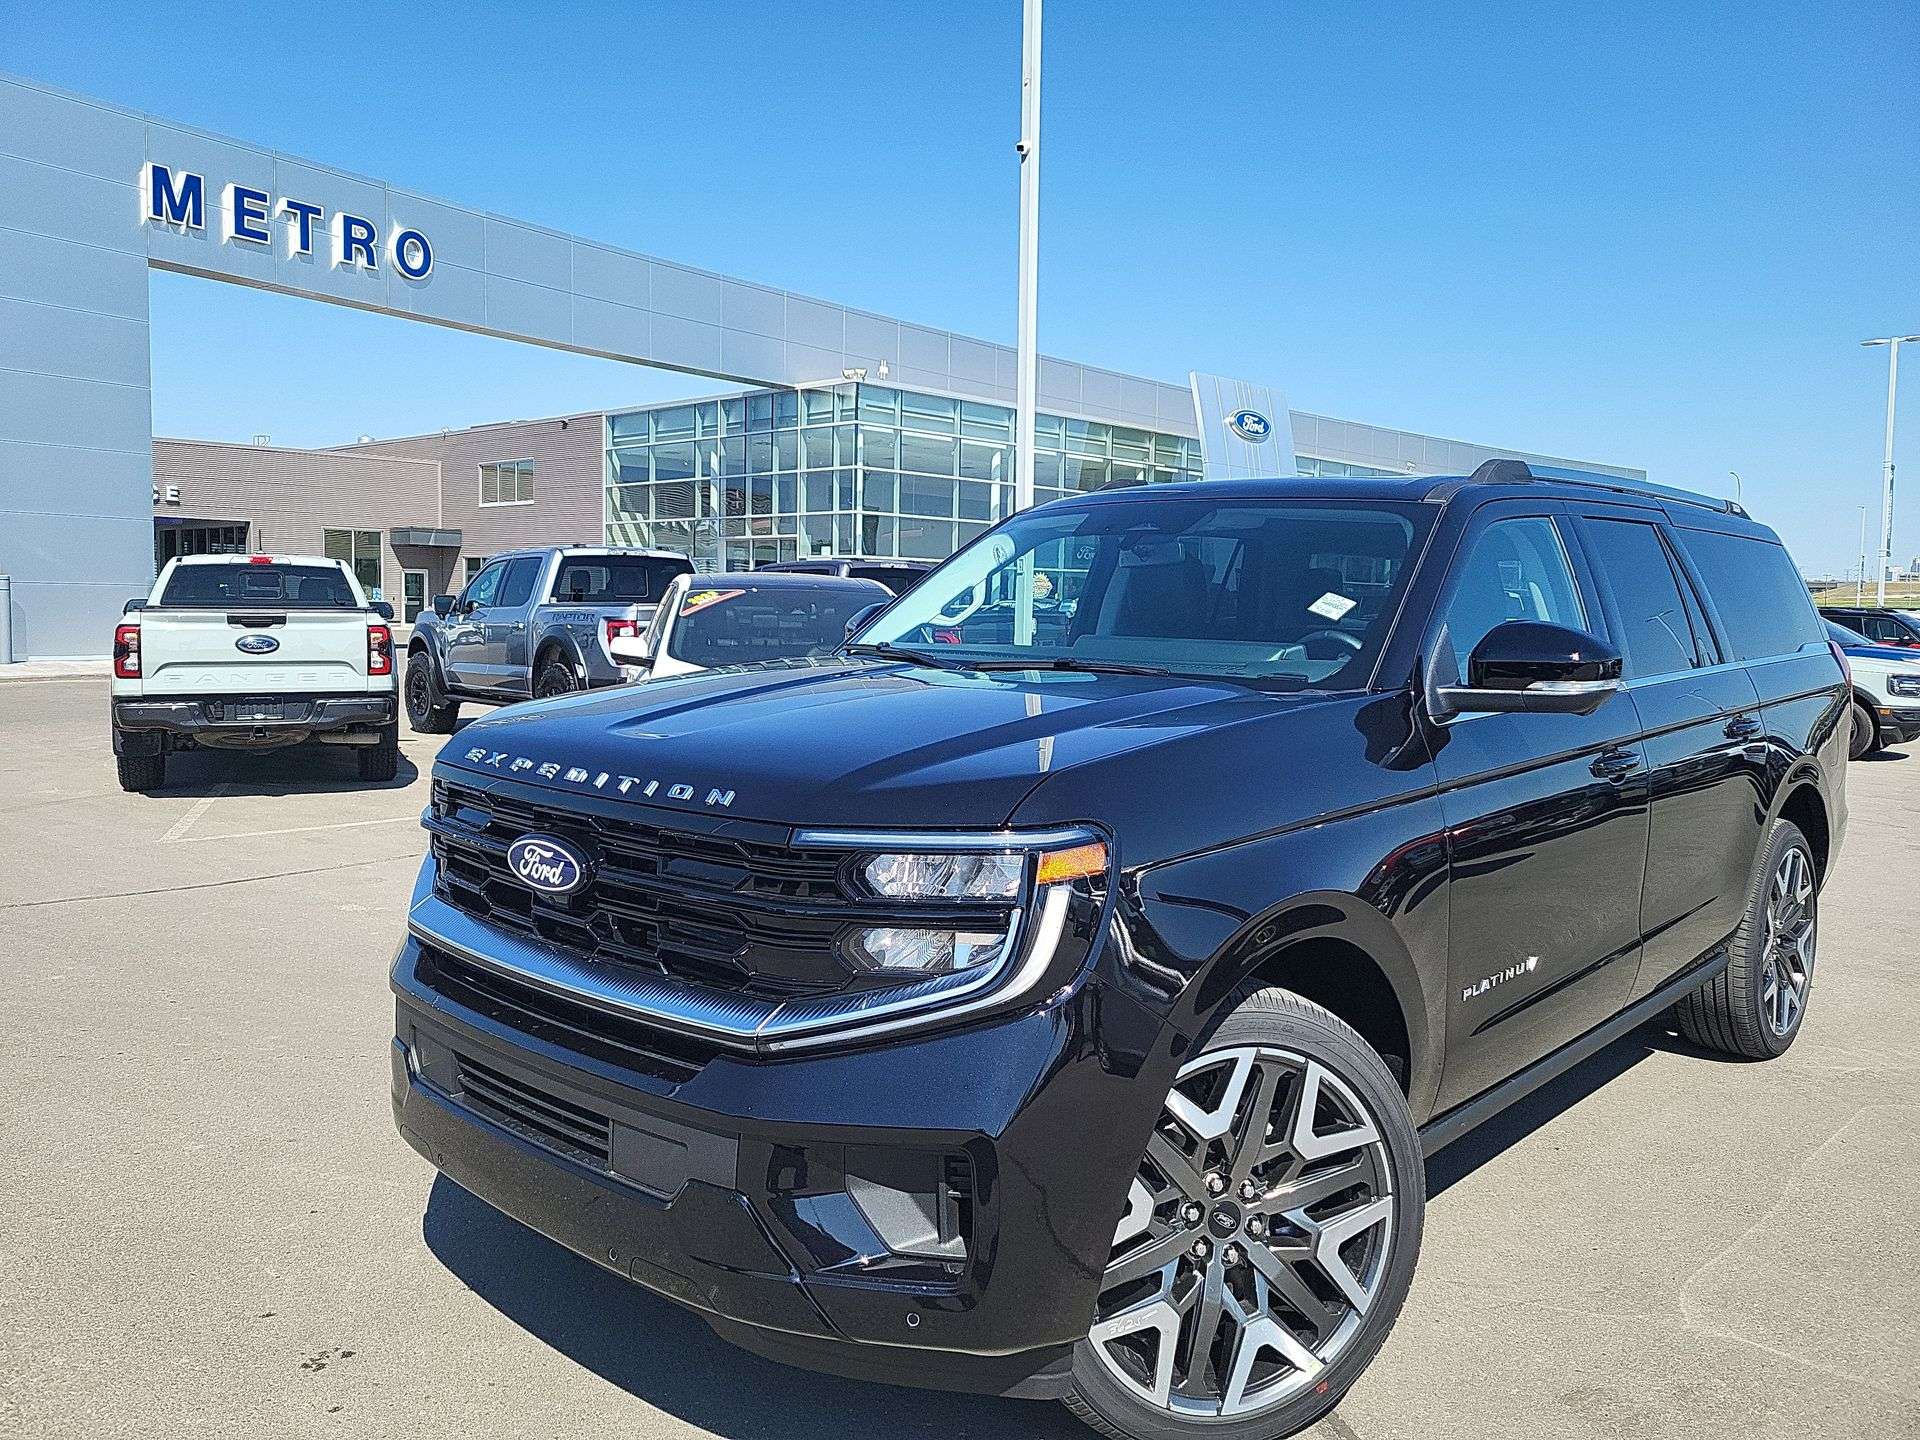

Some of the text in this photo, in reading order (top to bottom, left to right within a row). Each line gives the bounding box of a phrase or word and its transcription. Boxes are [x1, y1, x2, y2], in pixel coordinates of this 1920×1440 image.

[147, 162, 435, 280] METRO
[1242, 414, 1265, 434] Ford
[164, 672, 360, 684] RANGER
[465, 746, 736, 807] EXPEDITION
[519, 844, 565, 885] Ford
